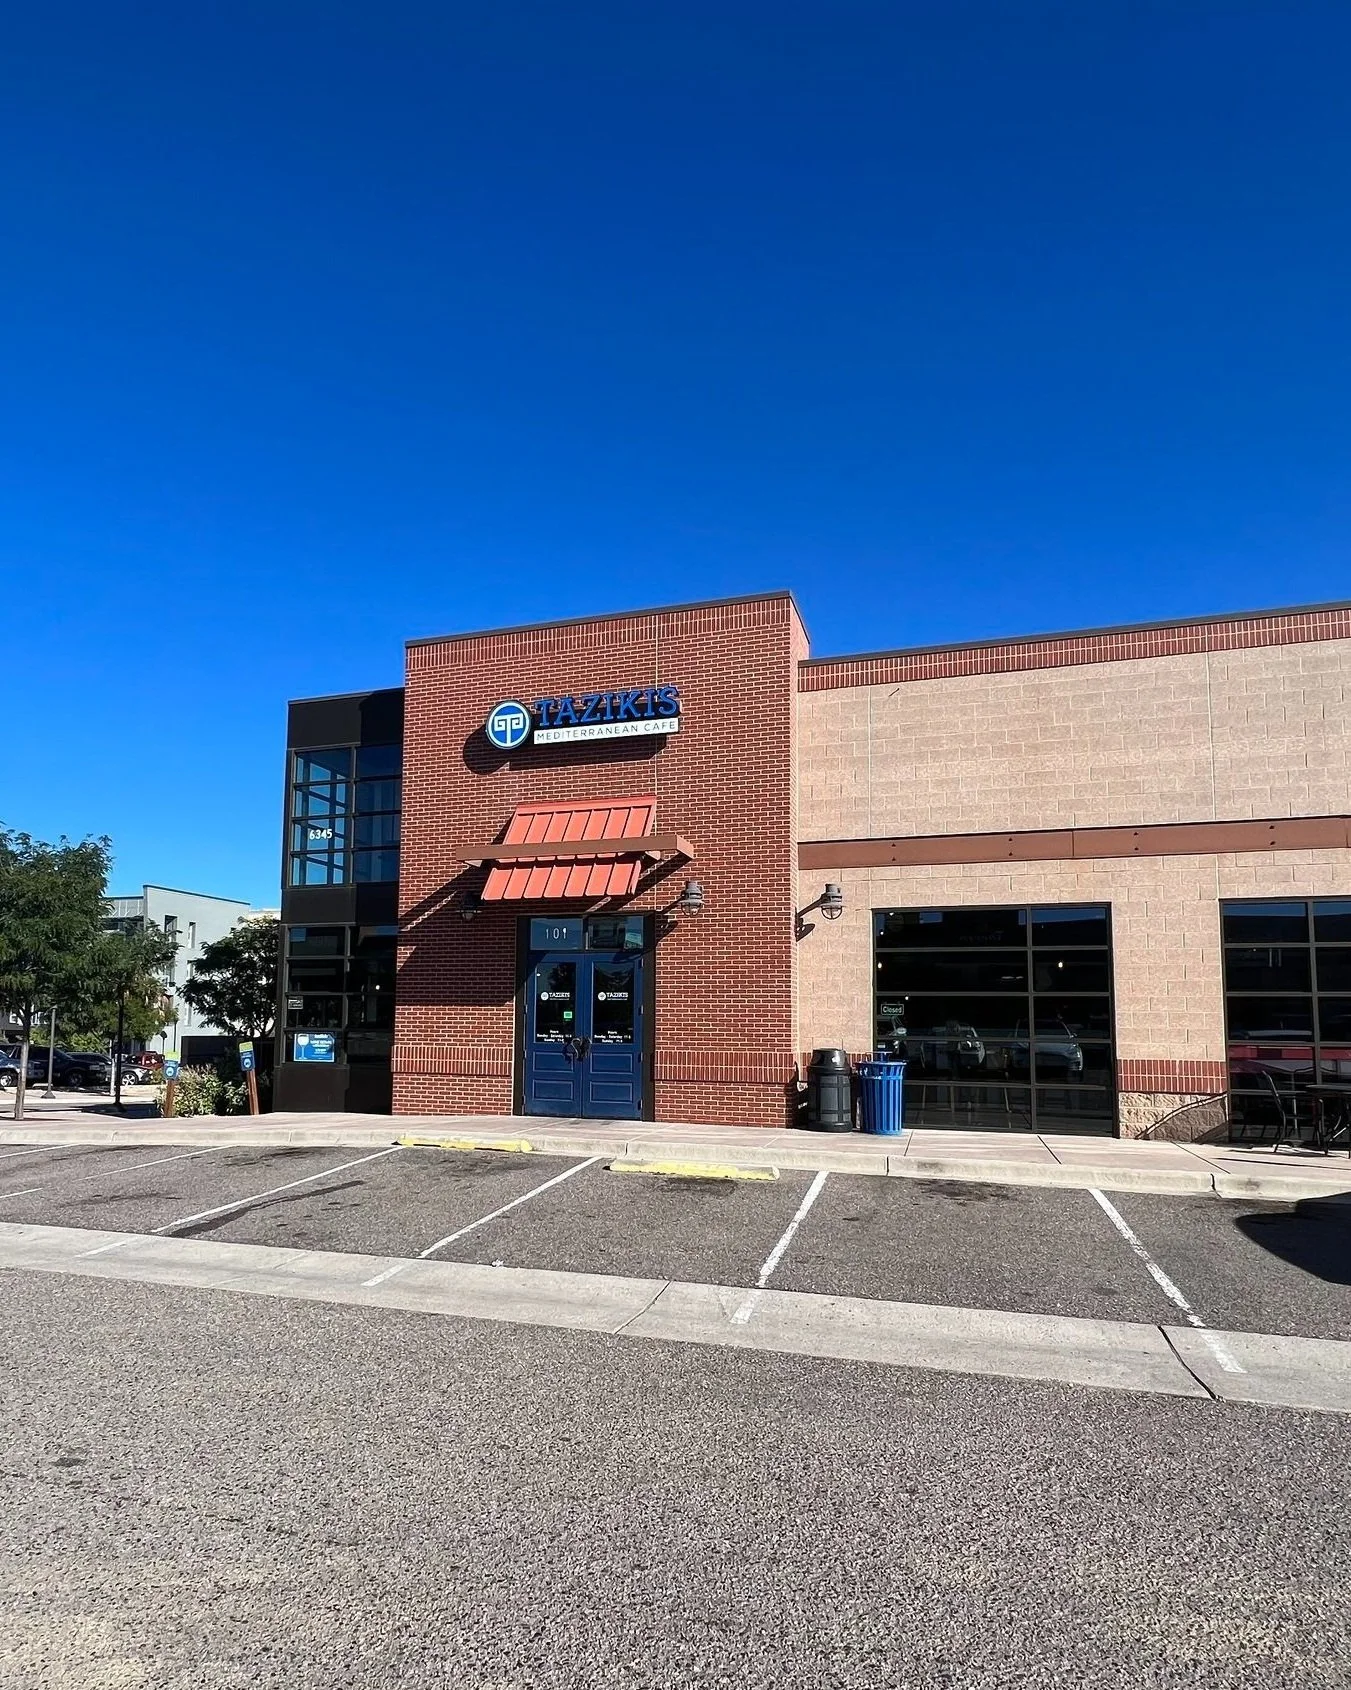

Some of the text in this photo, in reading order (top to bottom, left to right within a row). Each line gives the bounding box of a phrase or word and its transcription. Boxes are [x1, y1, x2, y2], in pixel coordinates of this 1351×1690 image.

[536, 721, 676, 741] MEDITERRANEAN CAFE
[309, 828, 333, 840] 6345
